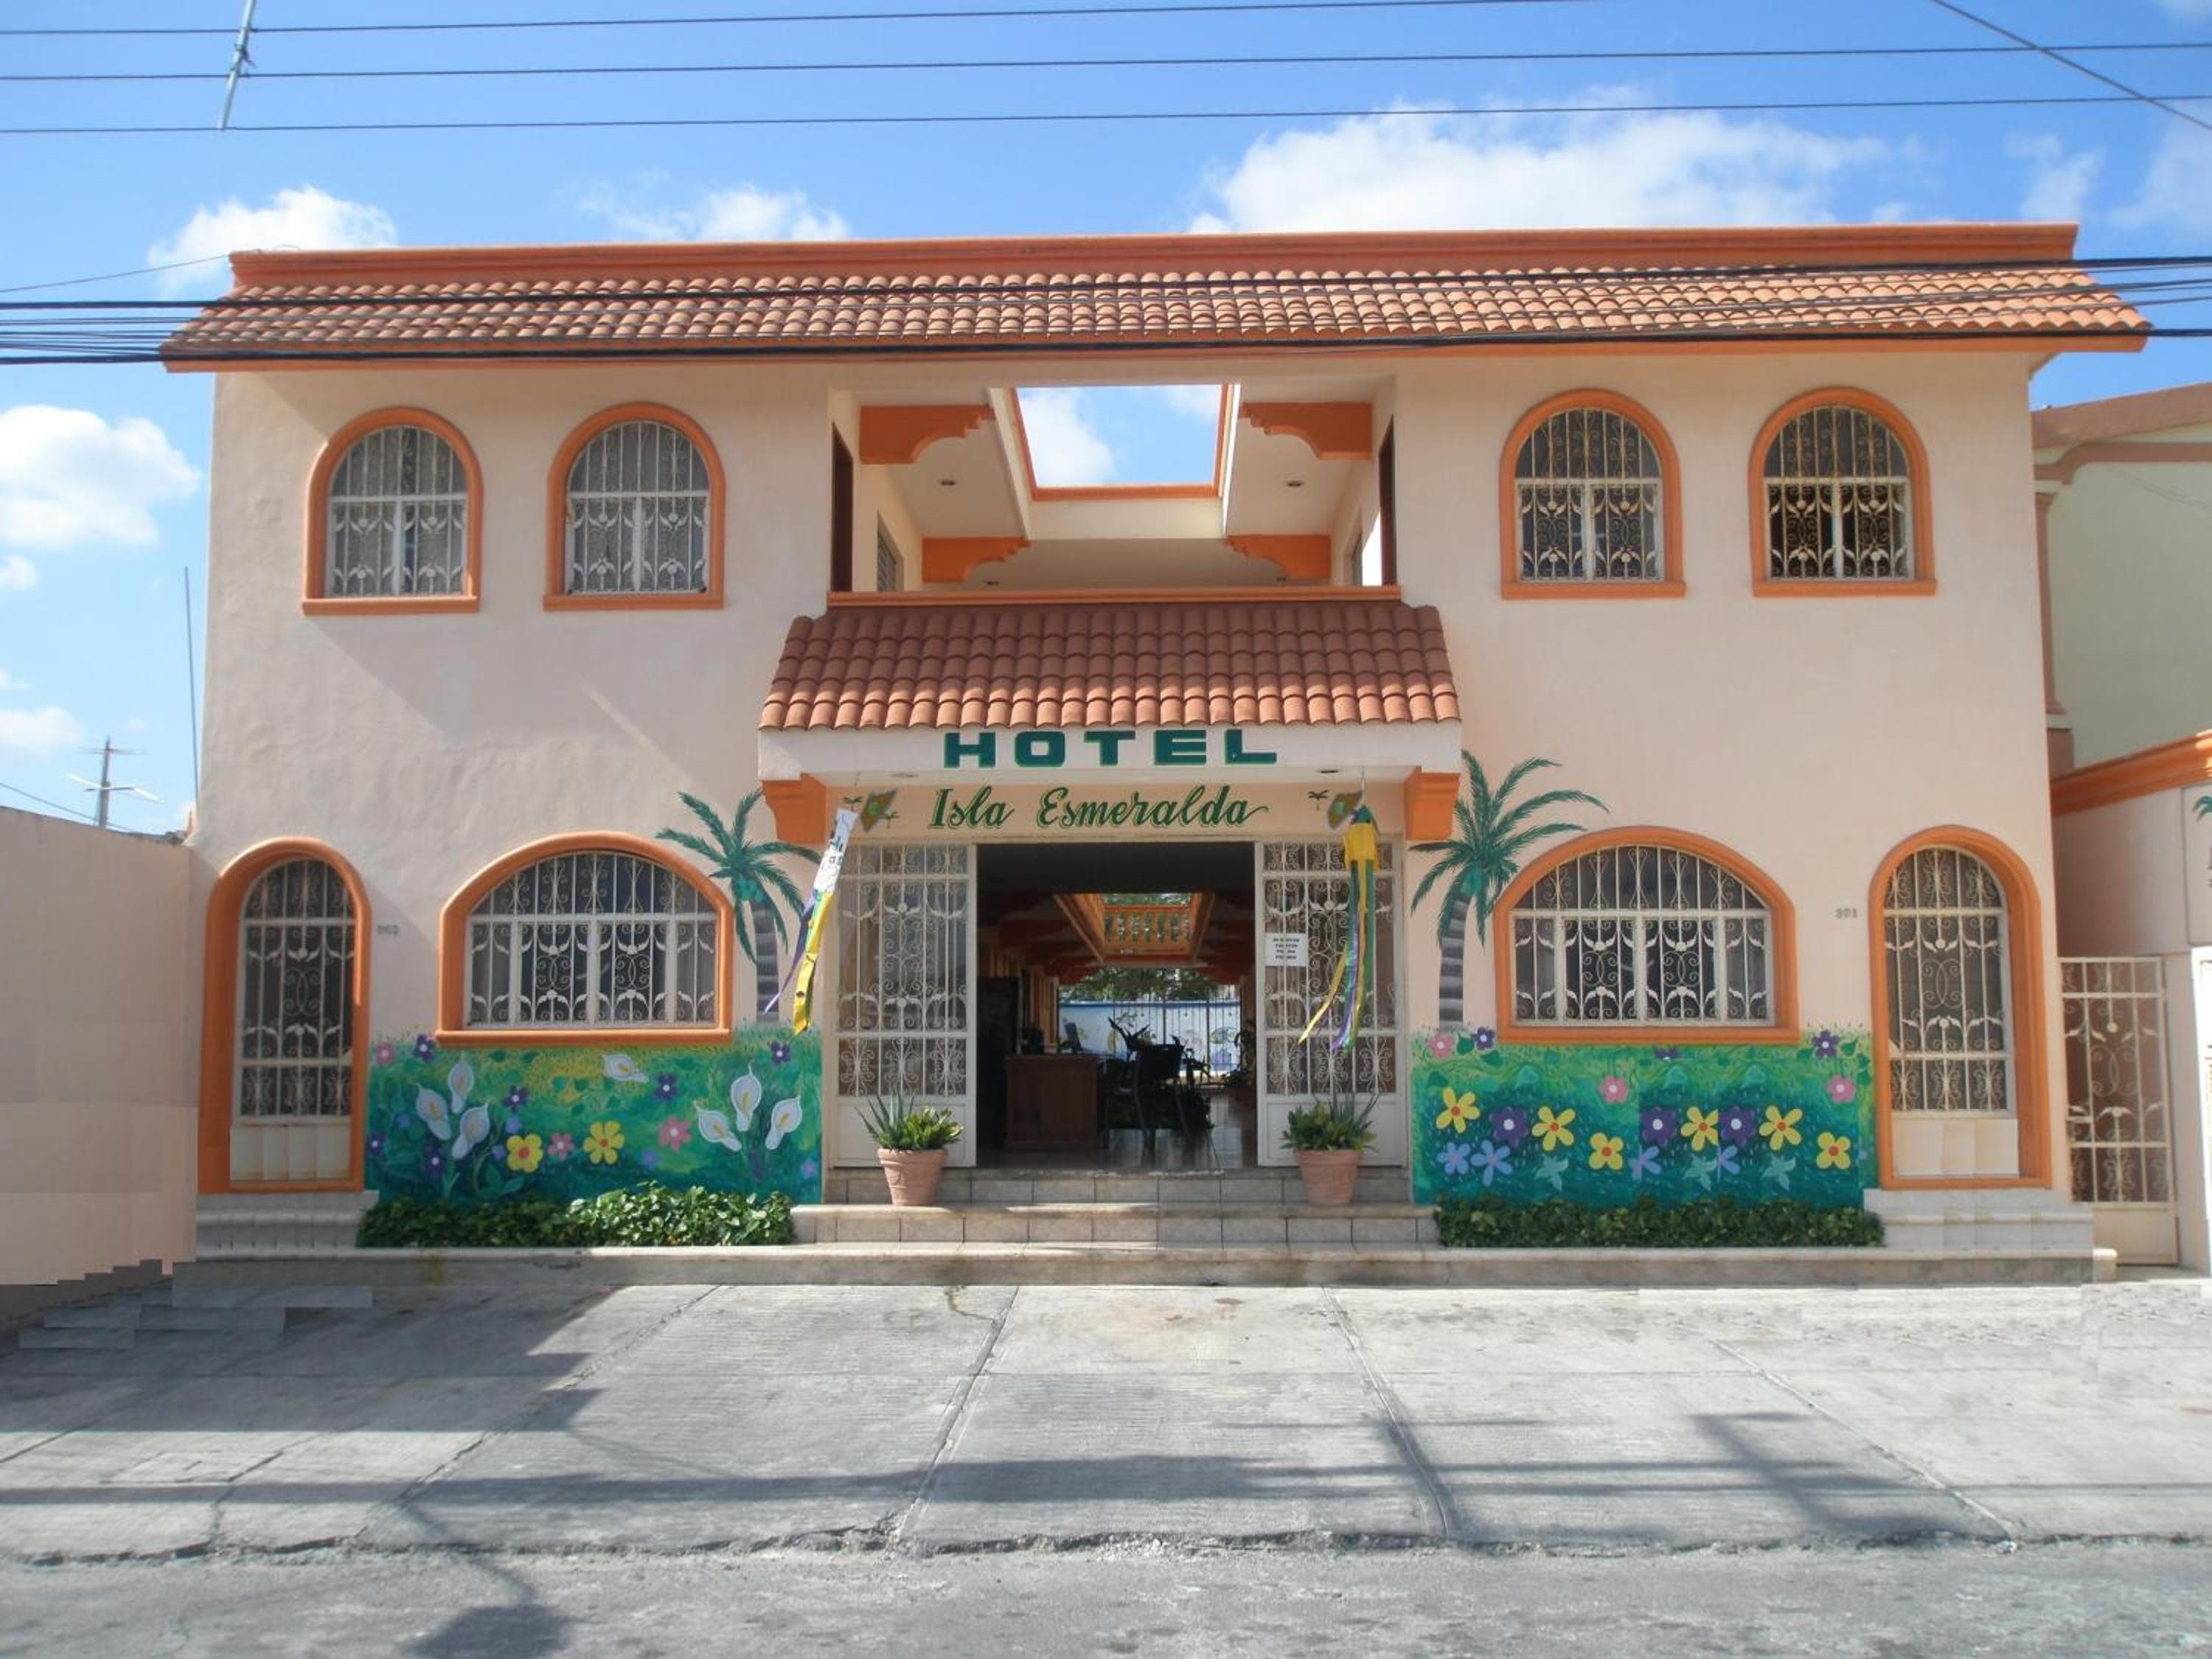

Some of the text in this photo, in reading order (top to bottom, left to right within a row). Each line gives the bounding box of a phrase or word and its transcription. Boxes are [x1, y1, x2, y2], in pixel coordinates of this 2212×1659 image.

[944, 729, 1277, 768] HOTEL
[927, 785, 1269, 830] Isla Esmeralda
